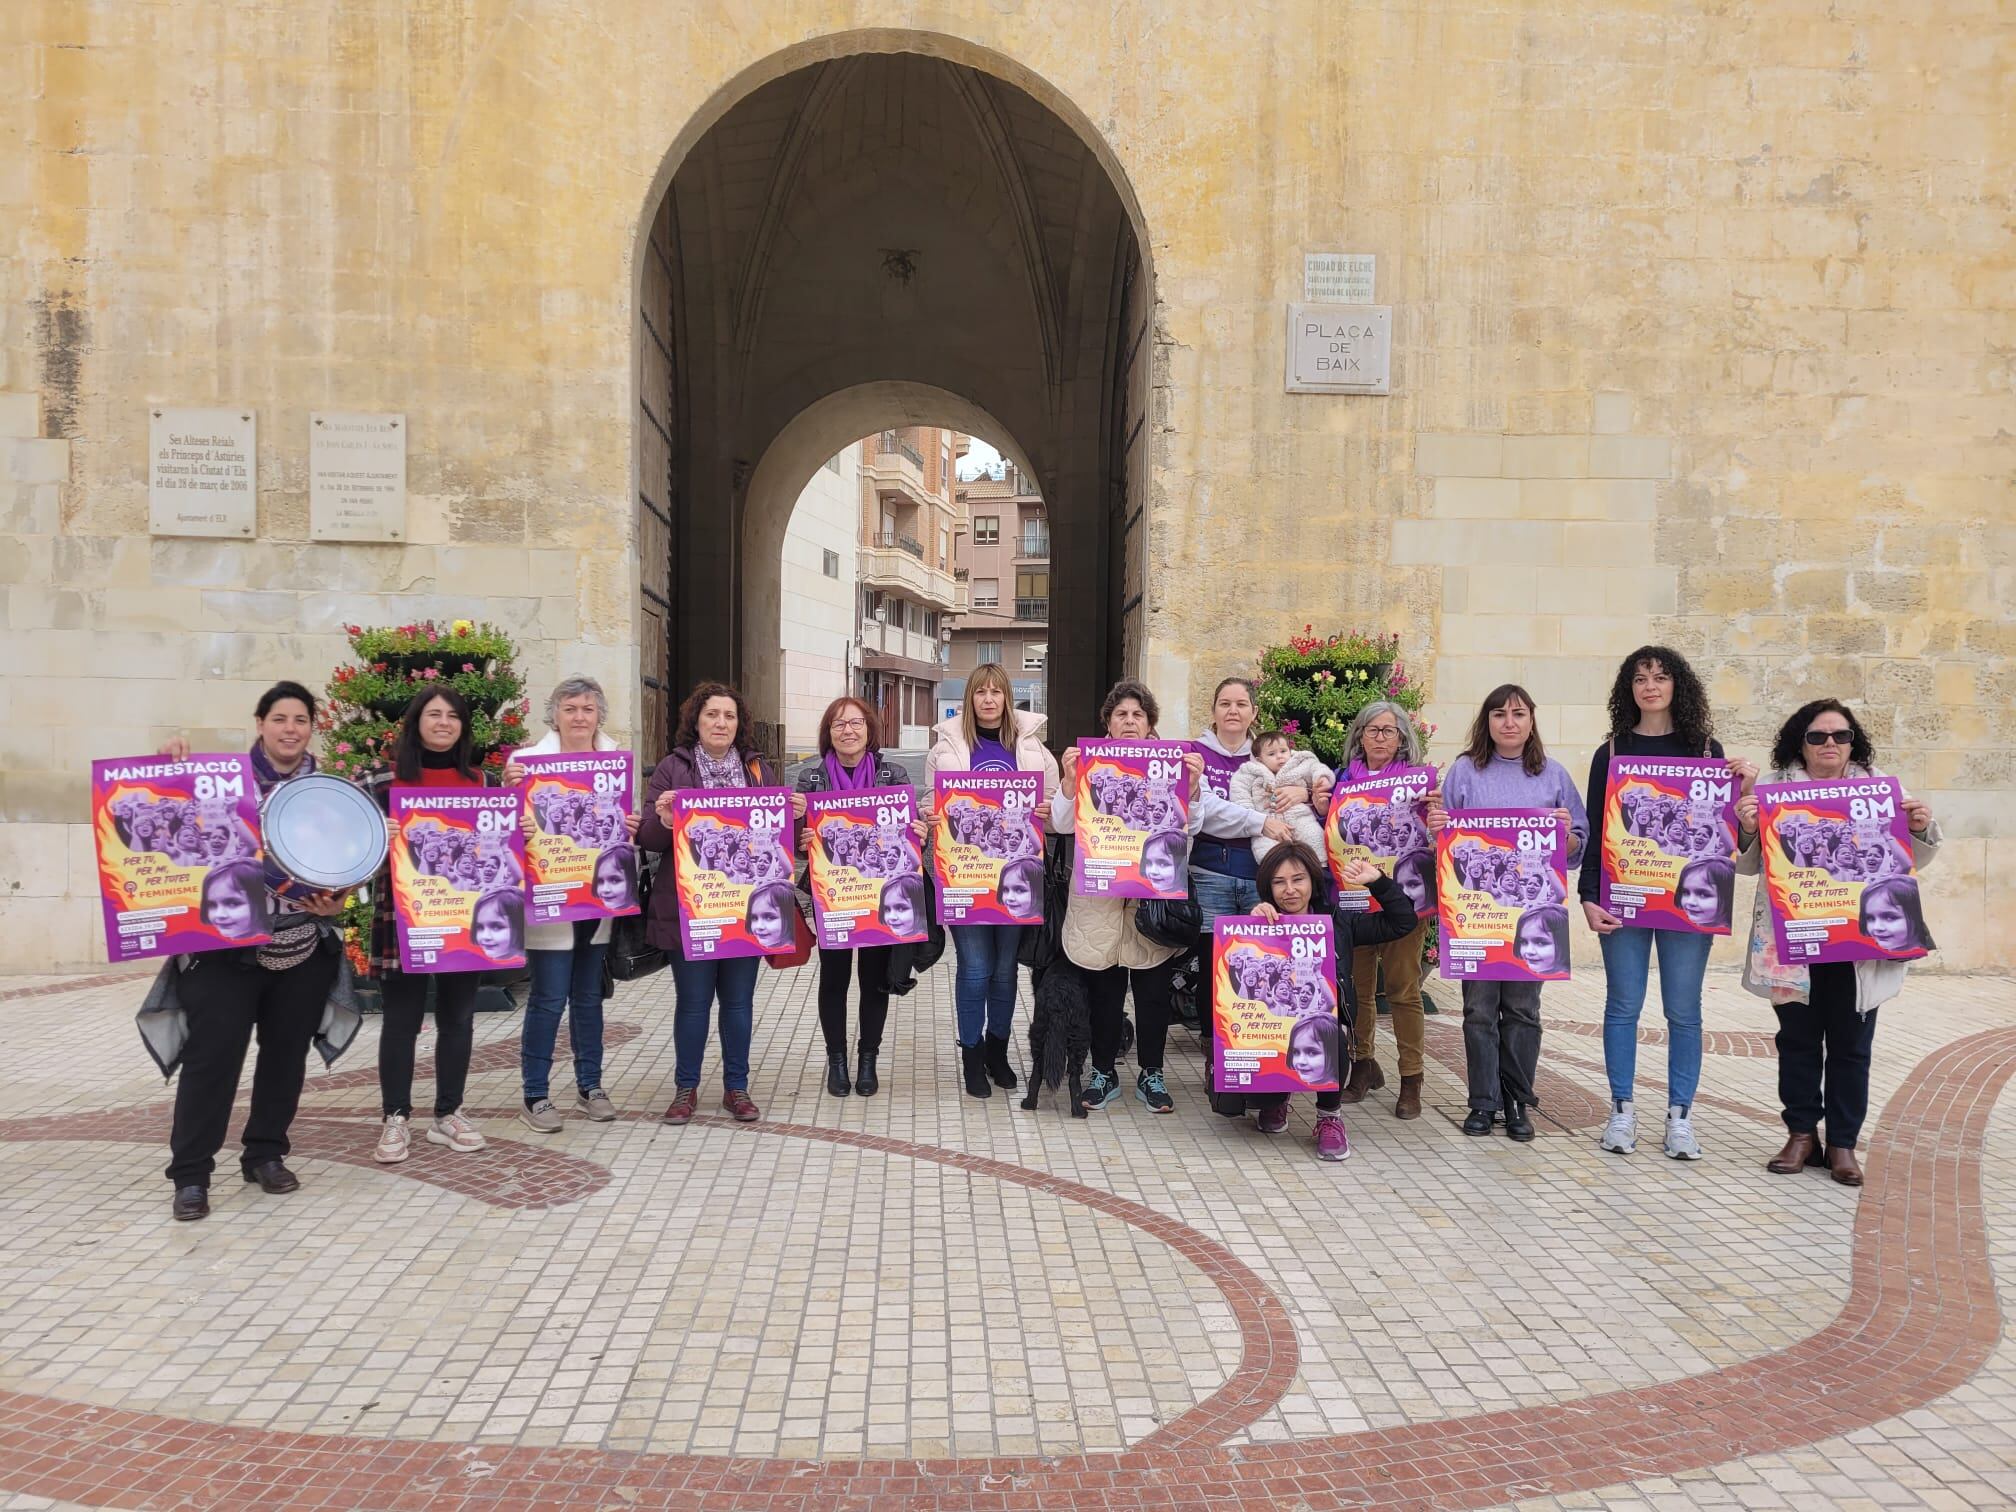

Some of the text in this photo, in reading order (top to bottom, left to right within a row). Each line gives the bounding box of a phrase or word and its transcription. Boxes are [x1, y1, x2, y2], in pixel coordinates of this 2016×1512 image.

[1338, 261, 1346, 272] DE
[1306, 324, 1374, 340] PLAÇA
[1330, 343, 1351, 353] DE
[1317, 358, 1360, 371] BAIX
[1086, 746, 1183, 758] MANIFESTACIÓ
[104, 759, 242, 781] MANIFESTACIÓ
[524, 757, 626, 775] MANIFESTACIÓ
[1148, 760, 1182, 779] 8M
[194, 775, 243, 800] 8M
[593, 772, 626, 792] 8M
[943, 776, 1036, 789] MANIFESTACIÓ
[1340, 772, 1428, 794] MANIFESTACIÓ
[1690, 780, 1731, 801] 8M
[401, 794, 517, 808] MANIFESTACIÓ
[682, 793, 785, 808] MANIFESTACIÓ
[814, 790, 908, 811] MANIFESTACIÓ
[1004, 790, 1035, 808] 8M
[1391, 786, 1427, 804] 8M
[1766, 782, 1891, 804] MANIFESTACIÓ
[876, 805, 910, 826] 8M
[1850, 797, 1896, 821] 8M
[477, 810, 516, 831] 8M
[750, 808, 785, 828] 8M
[1518, 830, 1556, 850] 8M
[124, 857, 141, 866] PER
[550, 865, 592, 873] FEMINISME
[136, 867, 152, 875] PER
[1630, 870, 1676, 878] FEMINISME
[146, 877, 161, 885] PER
[140, 886, 198, 898] FEMINISME
[838, 894, 876, 902] FEMINISME
[1804, 900, 1856, 908] FEMINISME
[1224, 920, 1326, 936] MANIFESTACIÓ
[1292, 937, 1326, 958] 8M
